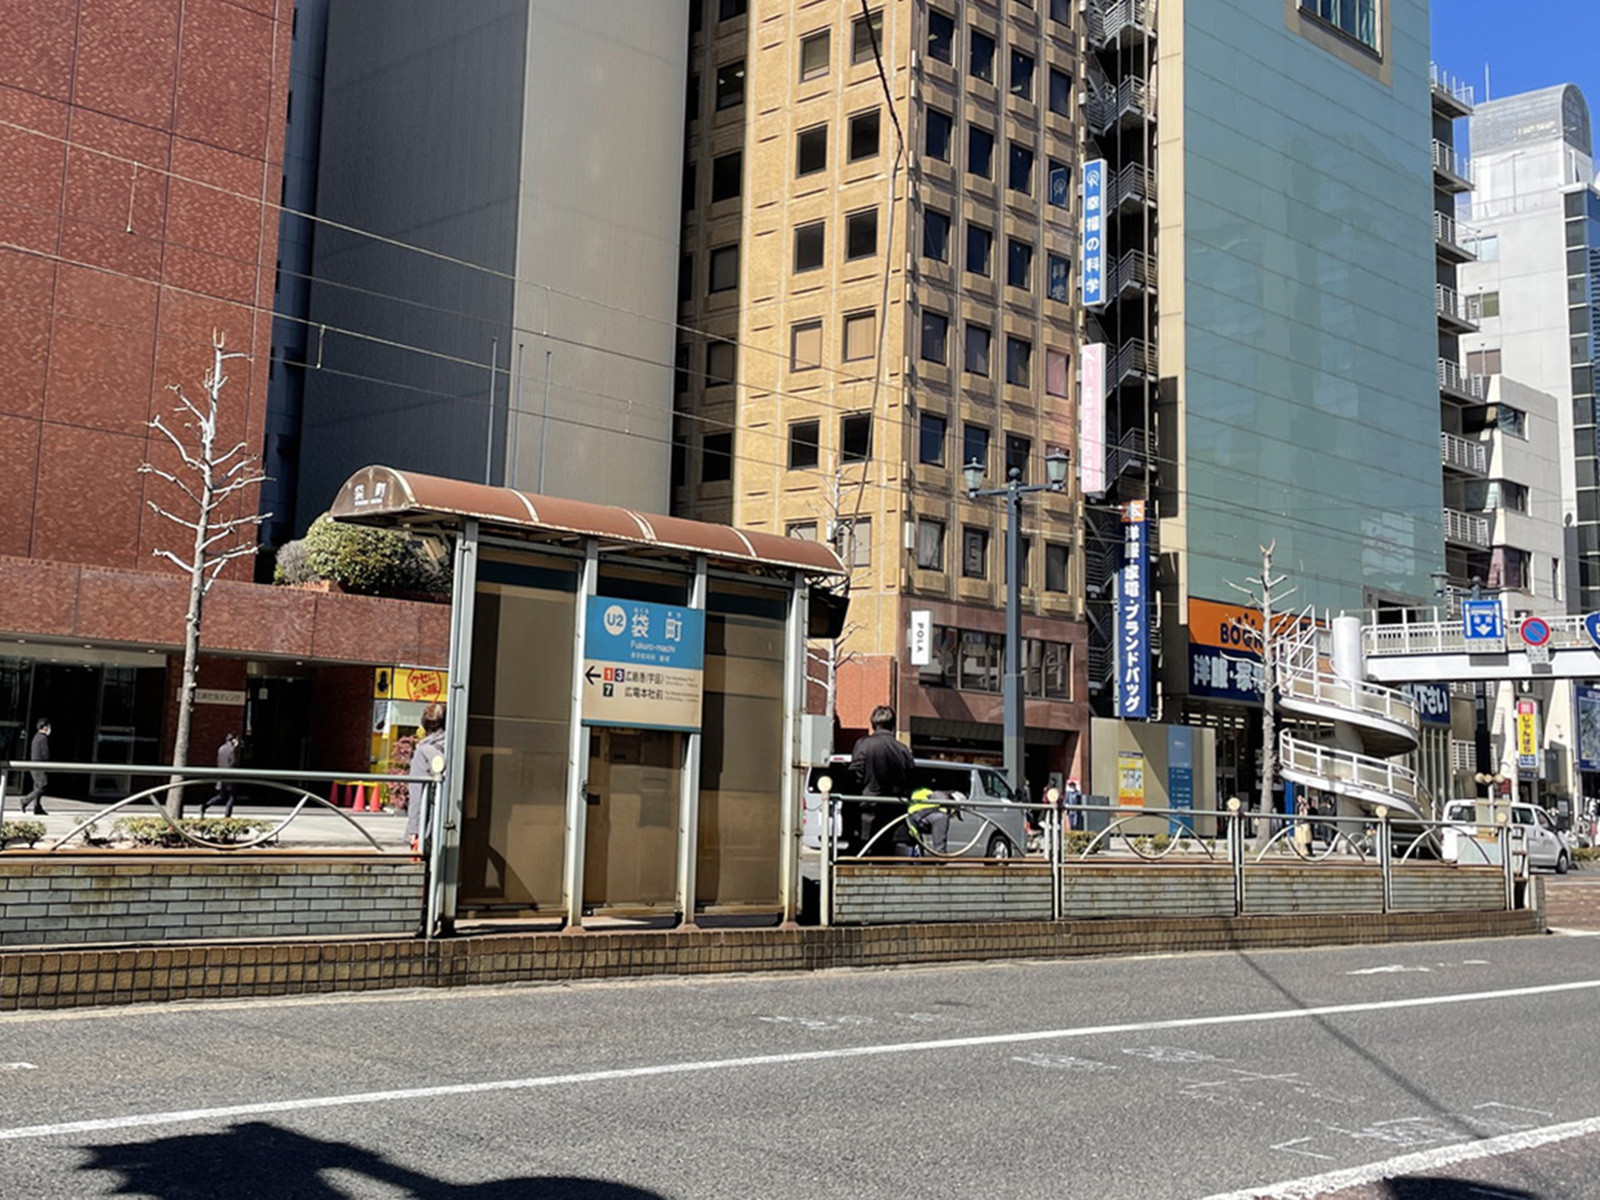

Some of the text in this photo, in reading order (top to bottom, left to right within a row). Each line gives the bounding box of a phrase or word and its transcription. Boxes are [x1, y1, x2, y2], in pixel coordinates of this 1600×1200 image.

[1086, 195, 1100, 294] 幸福の科学
[606, 613, 625, 628] U2
[631, 613, 683, 642] 袋町
[916, 622, 925, 653] POLA
